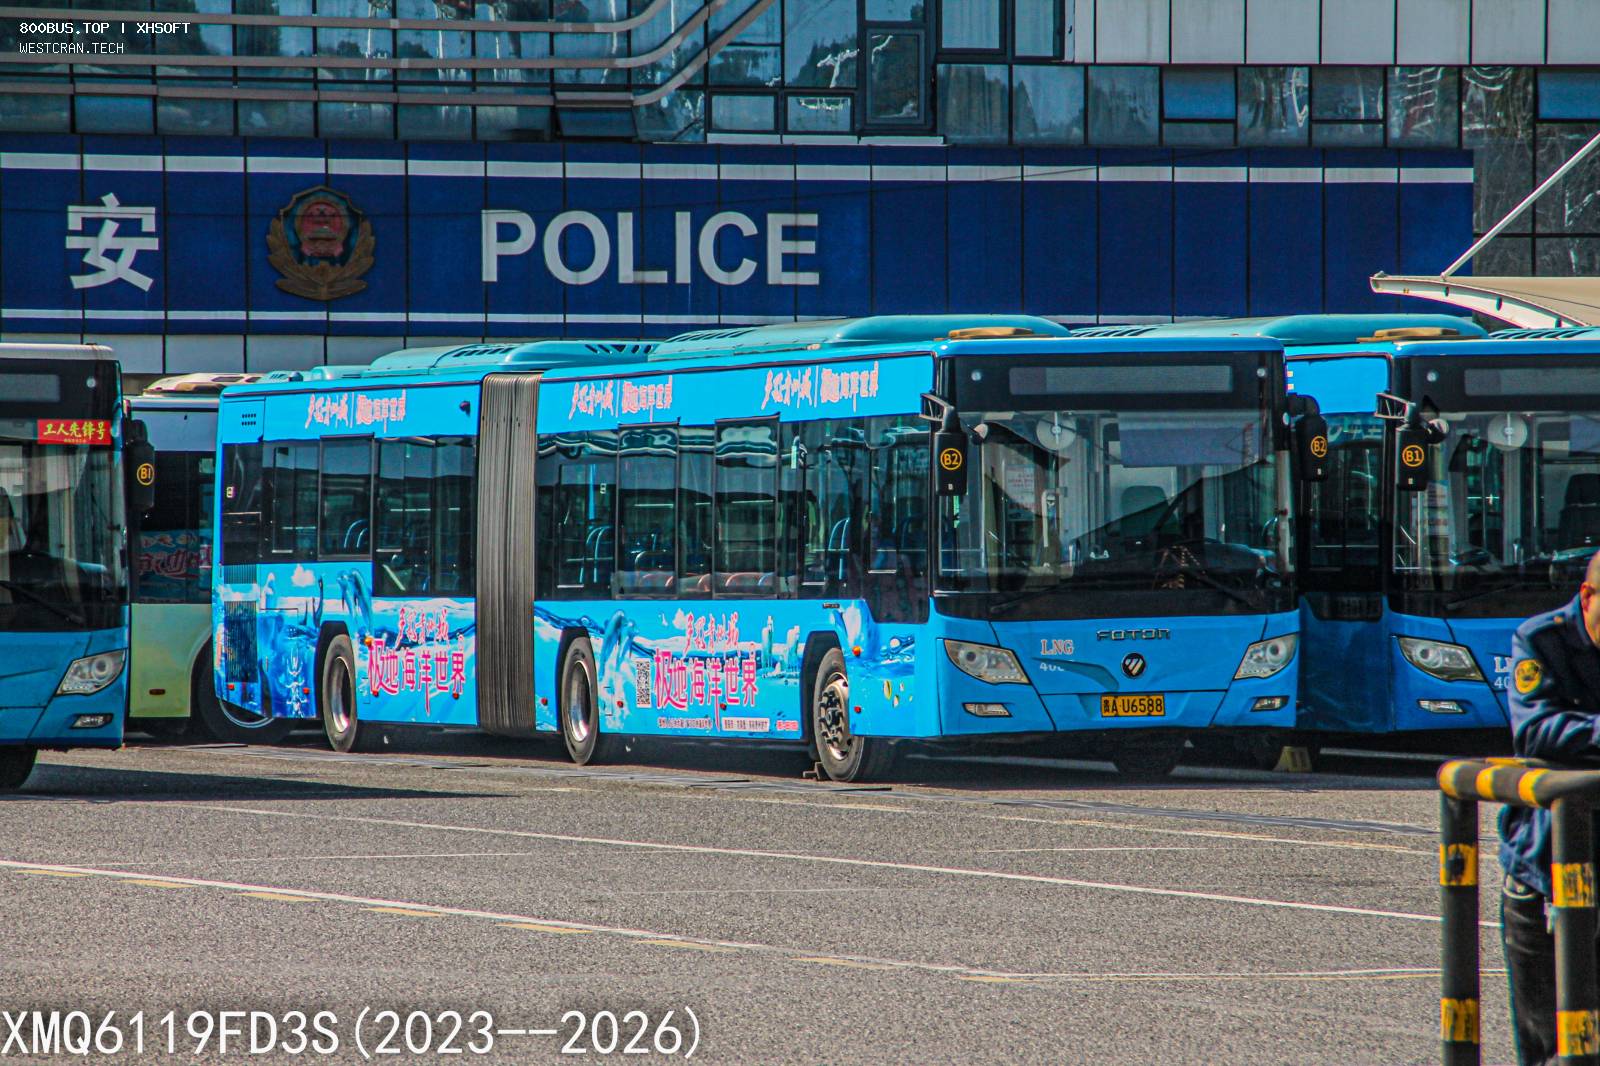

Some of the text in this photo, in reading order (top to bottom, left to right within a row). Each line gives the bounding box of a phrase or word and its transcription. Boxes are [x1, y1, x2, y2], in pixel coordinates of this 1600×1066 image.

[65, 192, 160, 292] 安
[481, 208, 820, 287] POLICE
[43, 421, 106, 440] 工人先锋号
[1313, 441, 1326, 452] B2
[943, 452, 960, 467] B2
[1405, 450, 1421, 462] B1
[1096, 628, 1171, 641] FOTON
[1040, 639, 1074, 656] LNG
[367, 638, 466, 717] 极地海洋世界
[654, 648, 758, 732] 极地海洋世界
